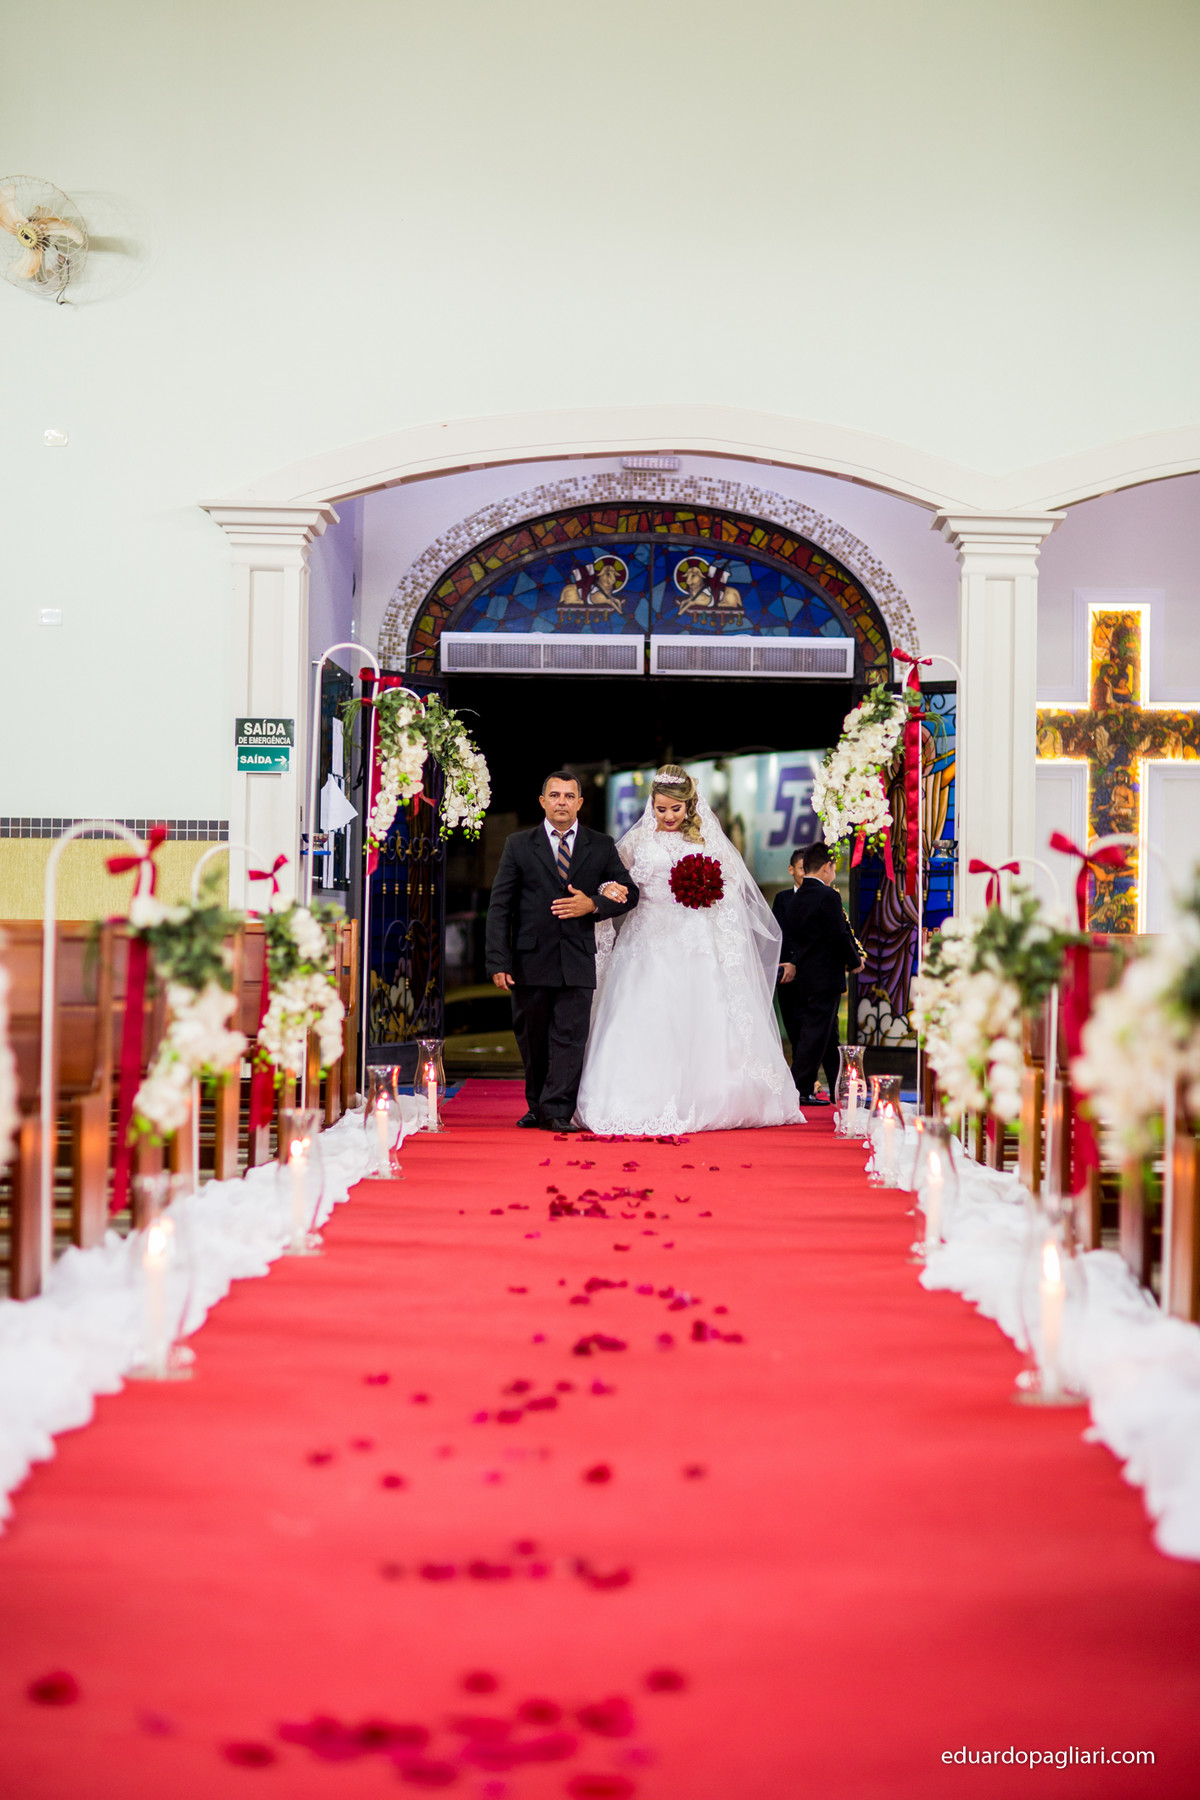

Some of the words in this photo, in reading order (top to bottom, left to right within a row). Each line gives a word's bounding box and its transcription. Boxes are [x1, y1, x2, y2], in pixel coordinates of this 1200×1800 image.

[243, 720, 286, 735] SAÍDA
[238, 736, 247, 744] DE
[249, 736, 291, 744] EMERGÊNCIA
[240, 754, 272, 764] SAÍDA
